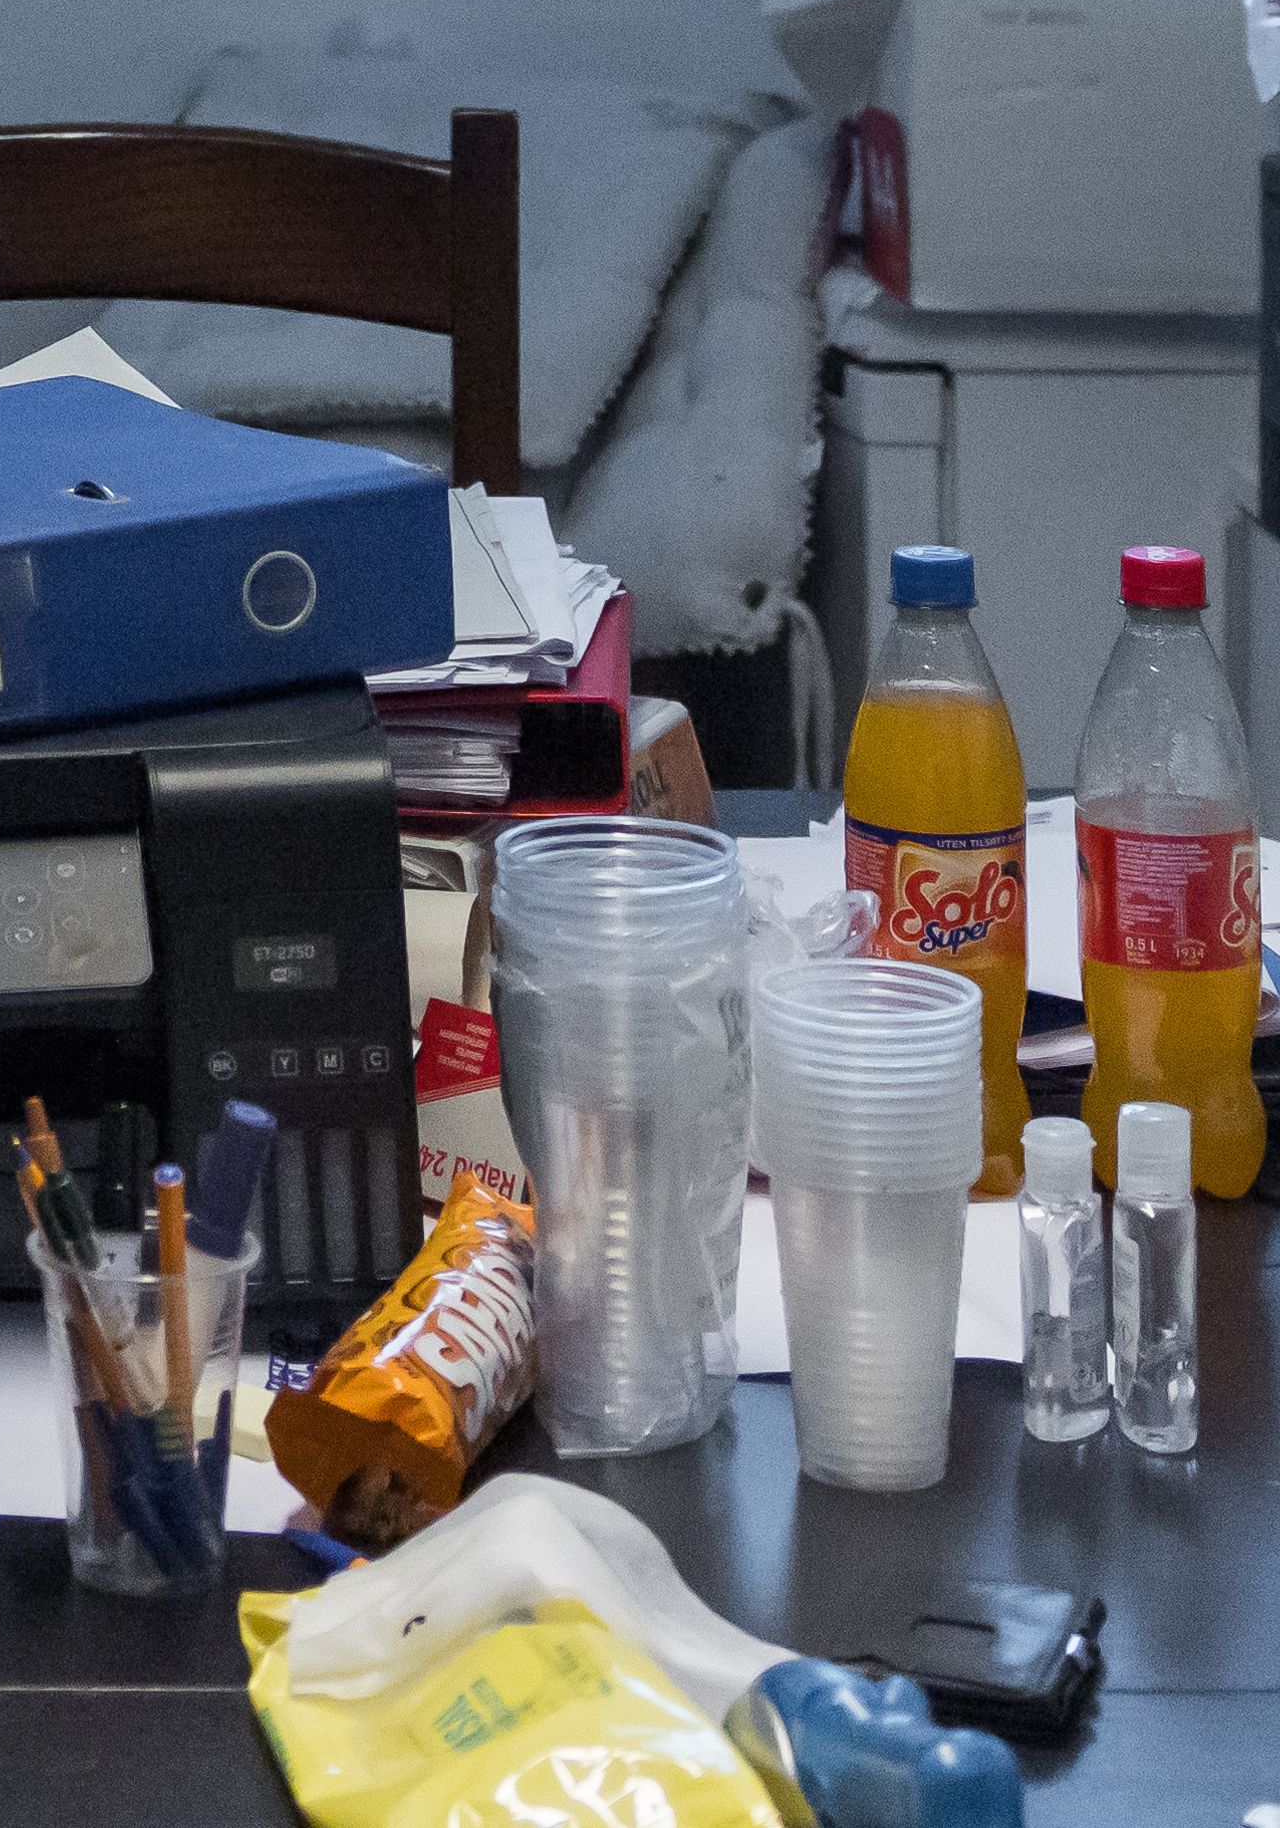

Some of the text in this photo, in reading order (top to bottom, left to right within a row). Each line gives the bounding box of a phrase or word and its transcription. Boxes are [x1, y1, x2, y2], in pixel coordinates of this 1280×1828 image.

[936, 839, 967, 849] UTEN
[891, 859, 1018, 944] Solo
[919, 919, 996, 955] Super
[1174, 945, 1205, 961] 1934
[452, 1157, 516, 1201] Rapid
